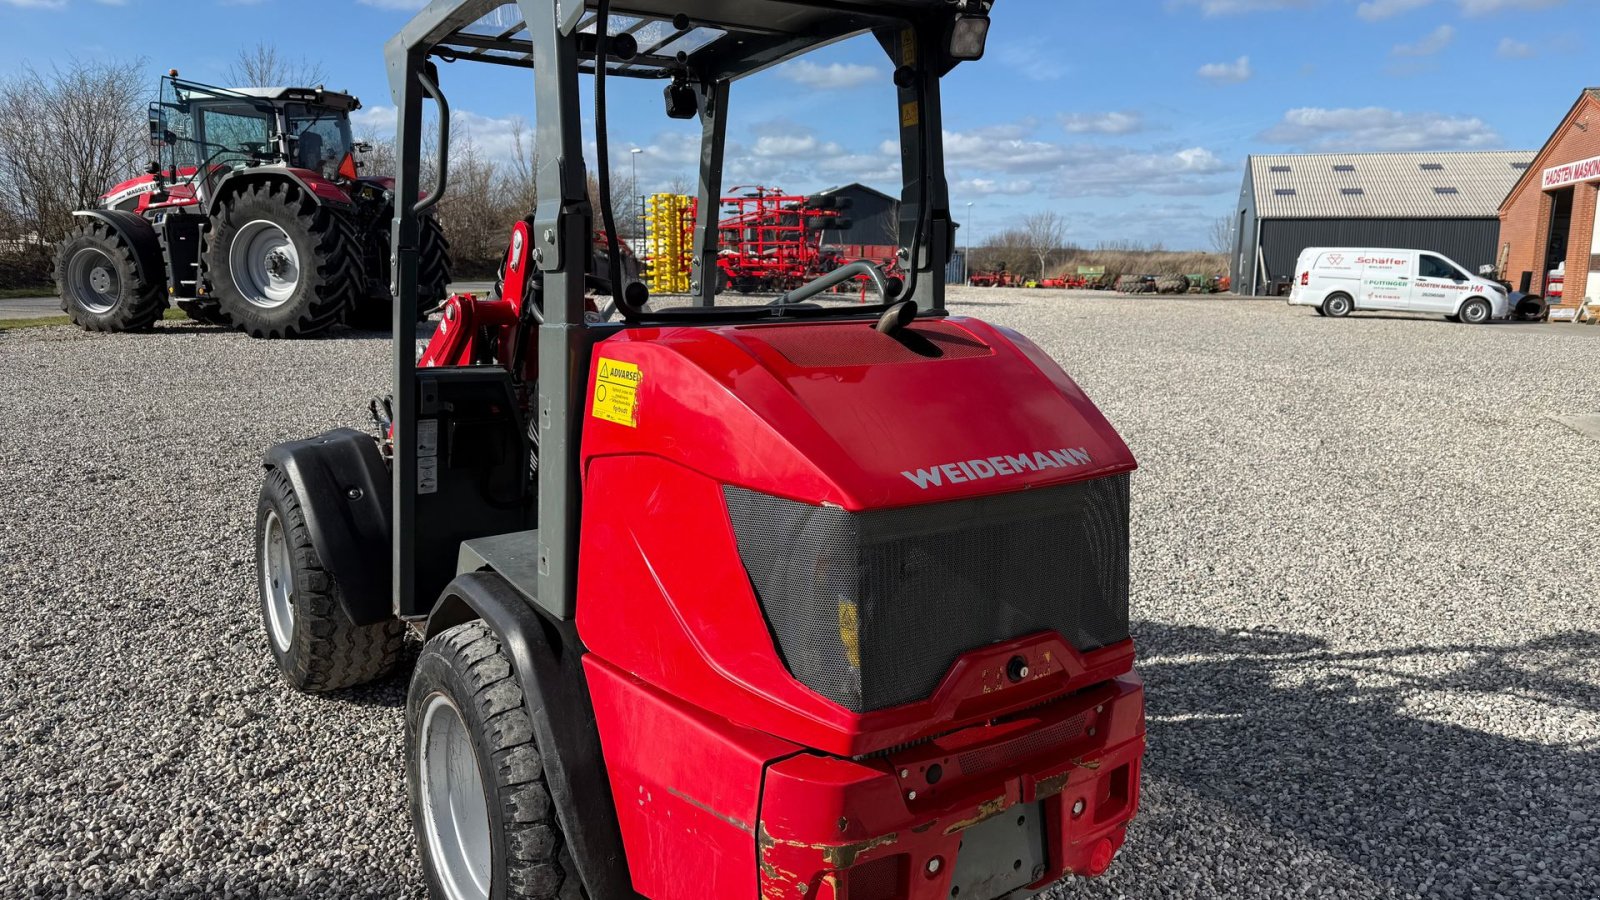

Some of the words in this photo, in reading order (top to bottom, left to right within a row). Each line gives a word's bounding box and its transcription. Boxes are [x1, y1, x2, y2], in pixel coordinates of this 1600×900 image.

[1545, 165, 1574, 186] HADSTEN
[126, 184, 149, 196] MASSEY
[901, 447, 1092, 490] WEIDEMANN
